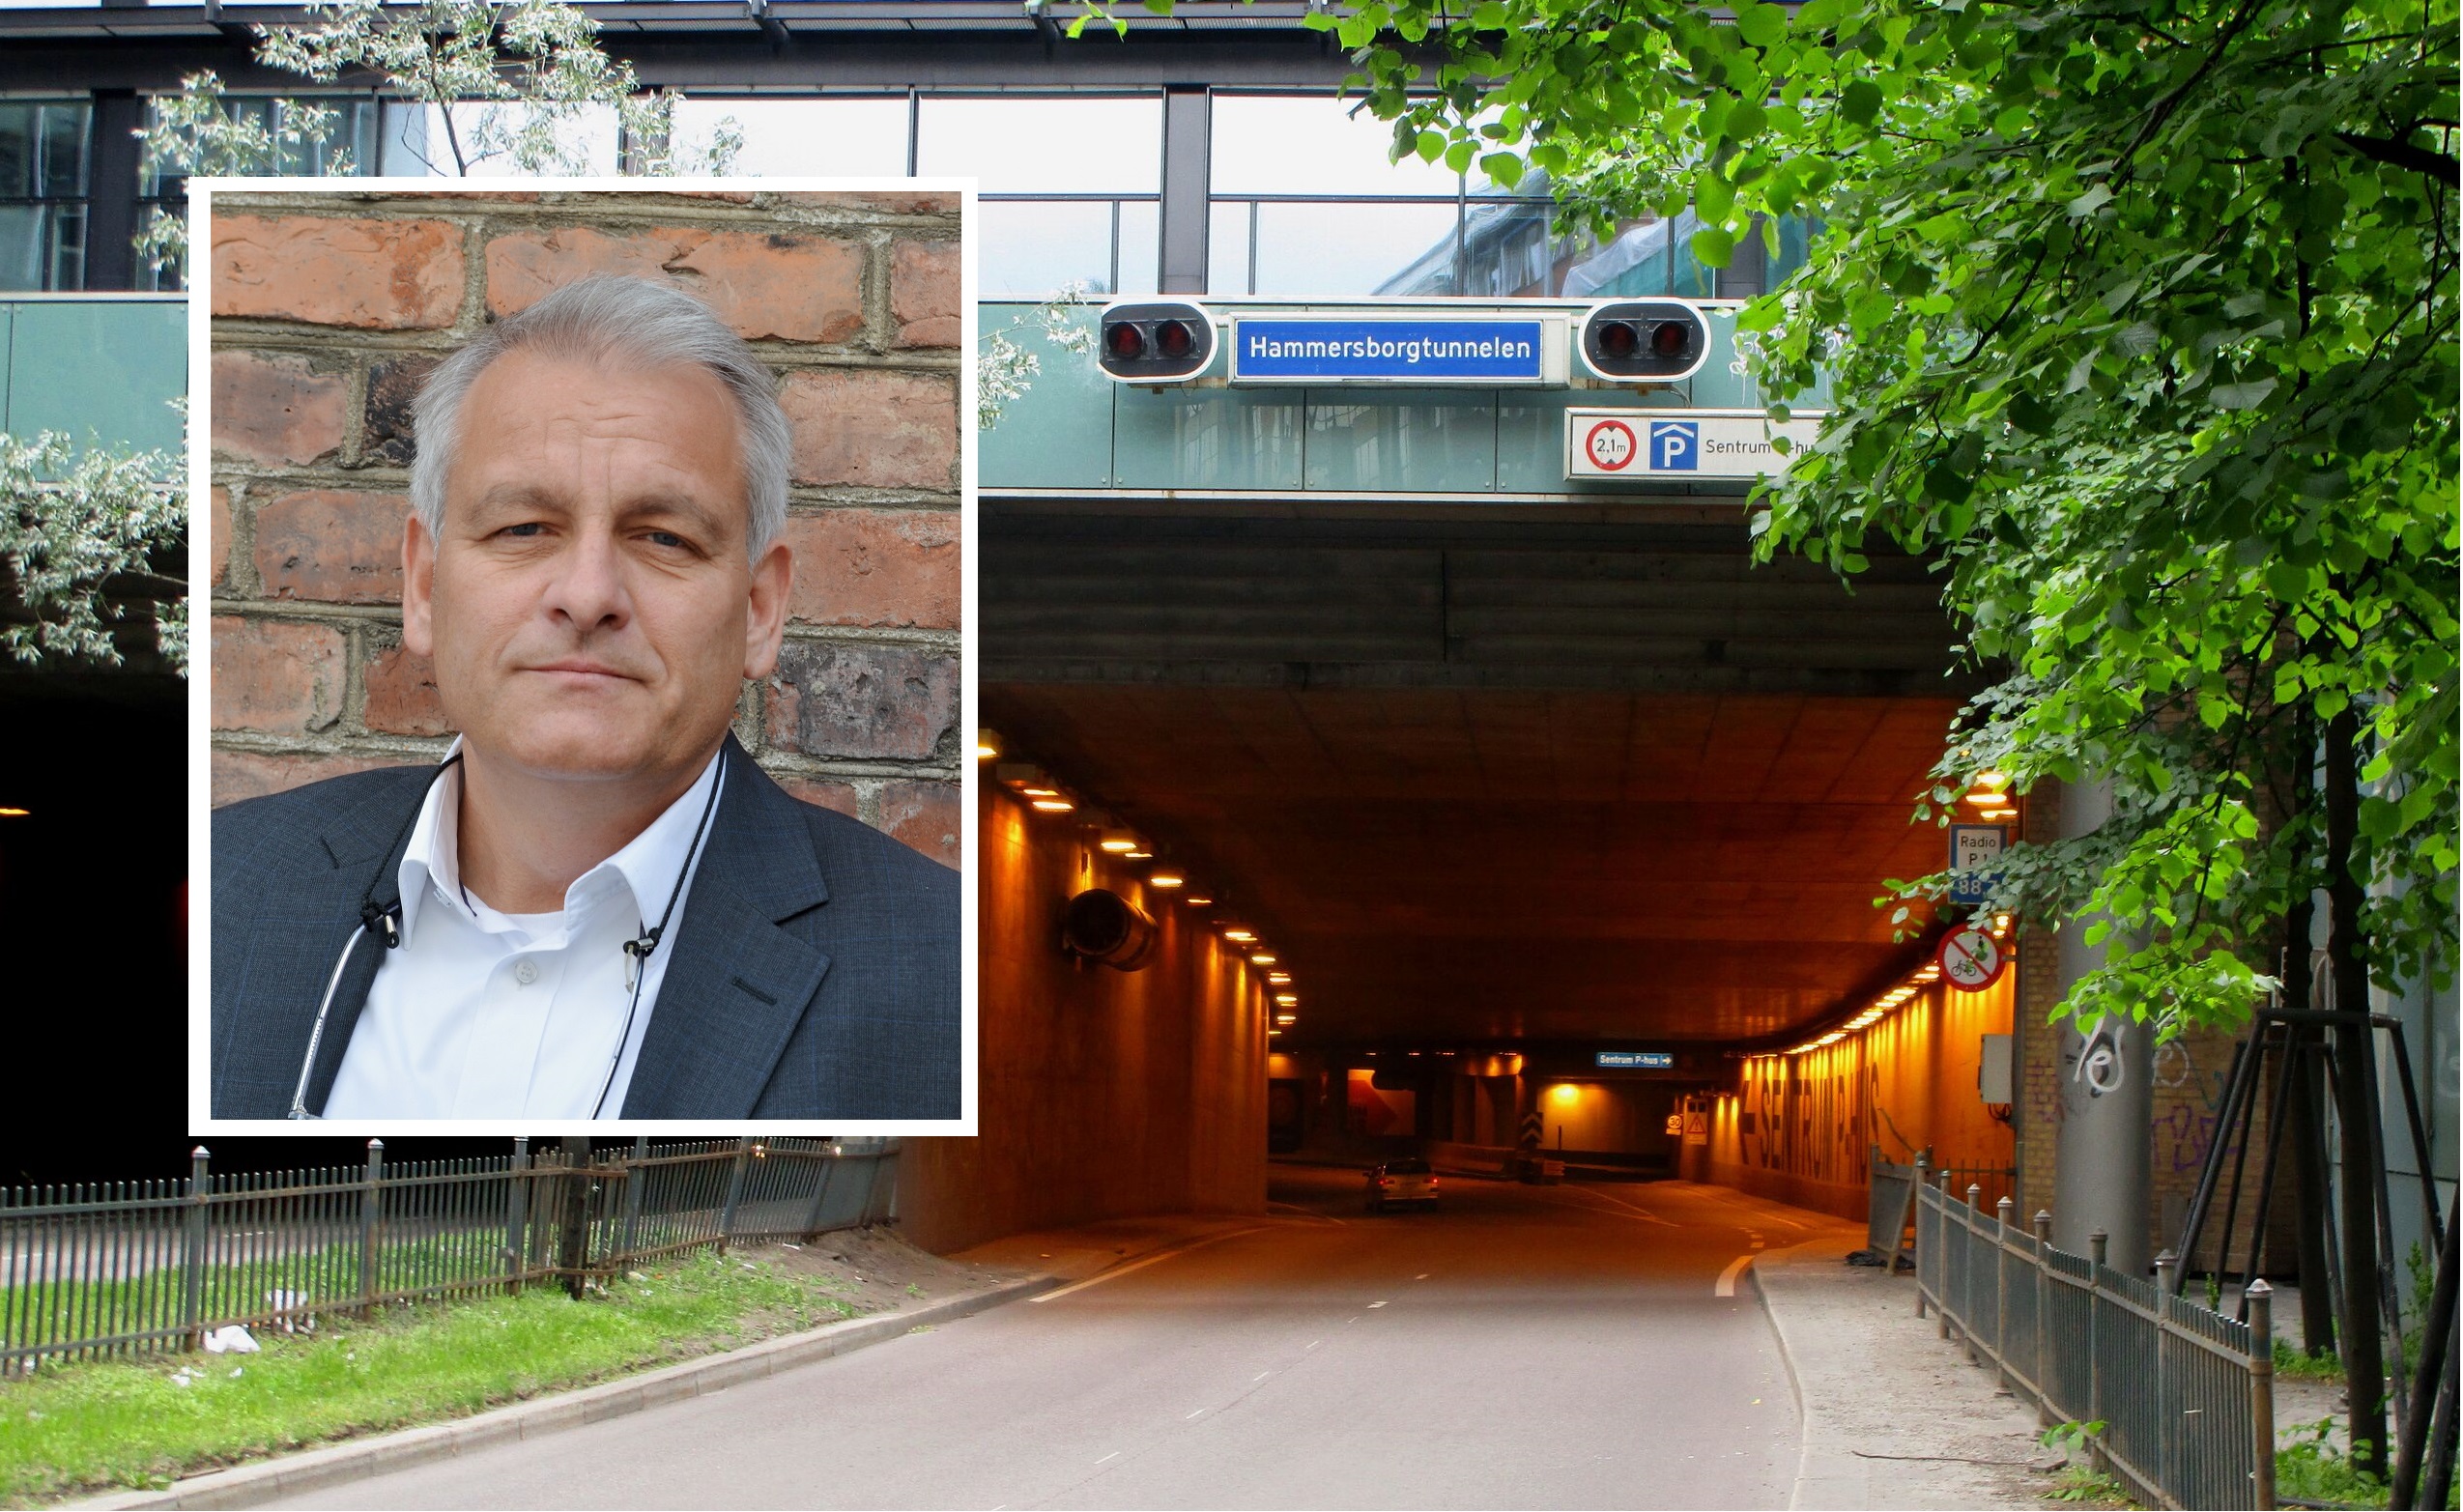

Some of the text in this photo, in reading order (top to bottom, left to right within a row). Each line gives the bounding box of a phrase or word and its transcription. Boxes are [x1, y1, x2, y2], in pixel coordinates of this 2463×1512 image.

[1249, 335, 1531, 364] Hammersborgtunnelen
[1664, 436, 1686, 468] P
[1705, 439, 1771, 454] Sentrum
[1961, 836, 1996, 848] Radio
[1599, 1054, 1658, 1065] Sentrum P-hus
